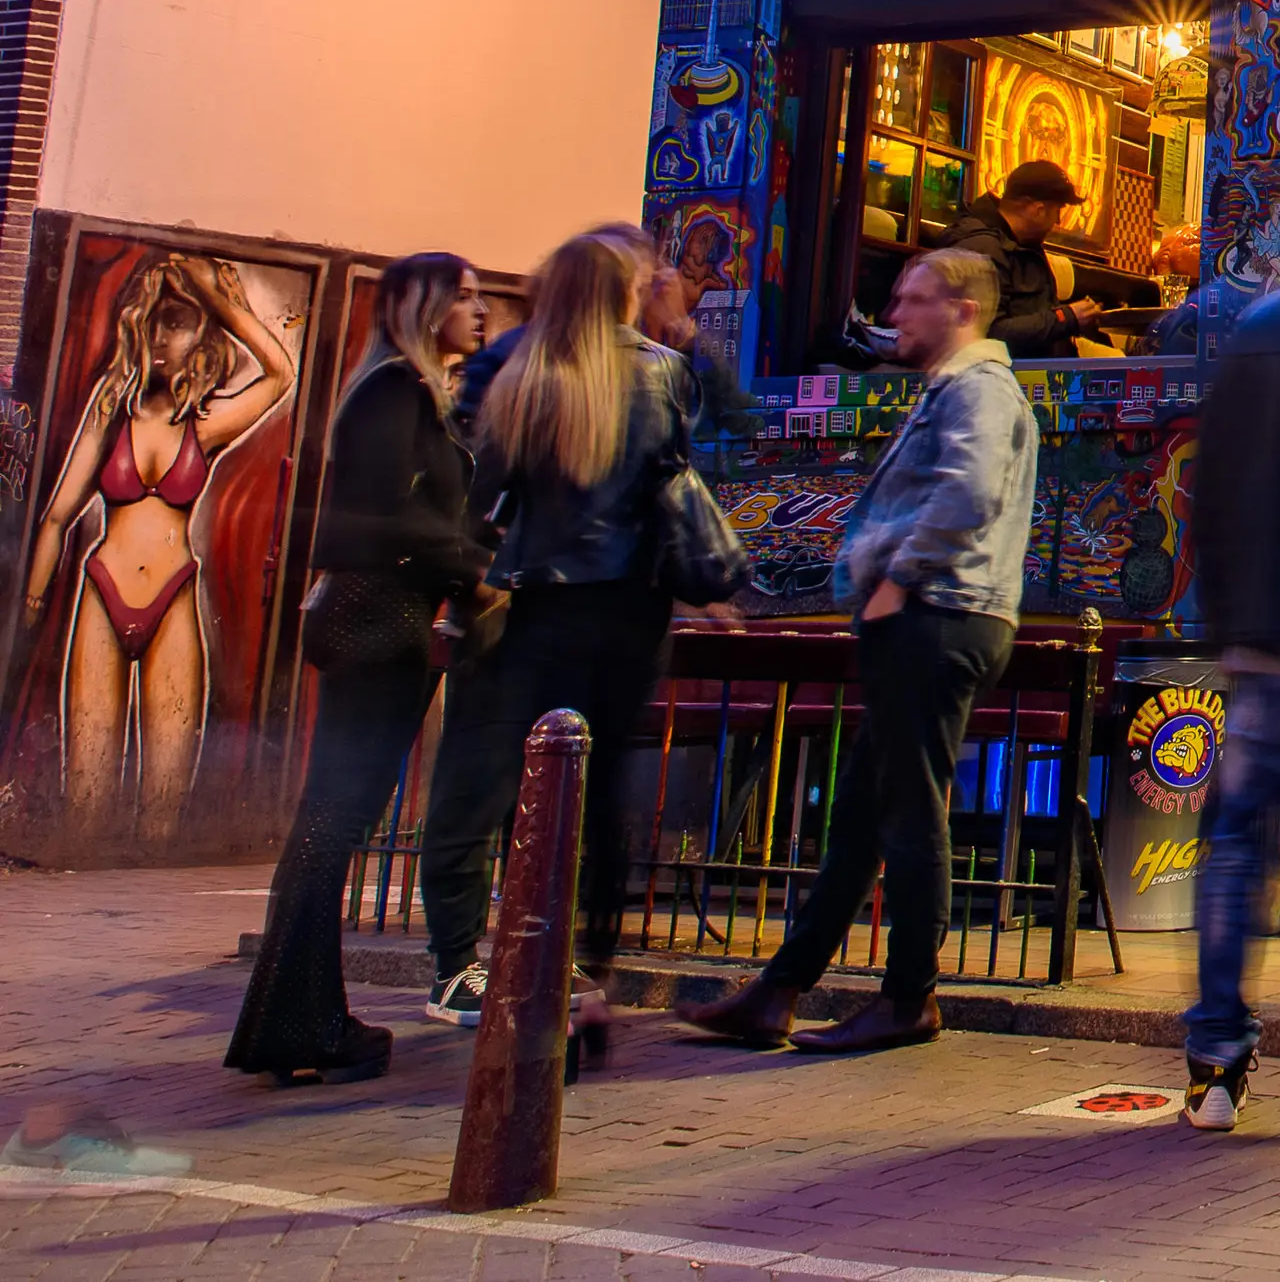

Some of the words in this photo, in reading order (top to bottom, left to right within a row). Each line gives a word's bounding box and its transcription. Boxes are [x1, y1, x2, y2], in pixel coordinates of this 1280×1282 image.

[1127, 695, 1166, 748] THE
[1157, 686, 1226, 746] BULLDOG
[1129, 768, 1187, 815] ENERGY
[1150, 870, 1191, 887] ENERGY
